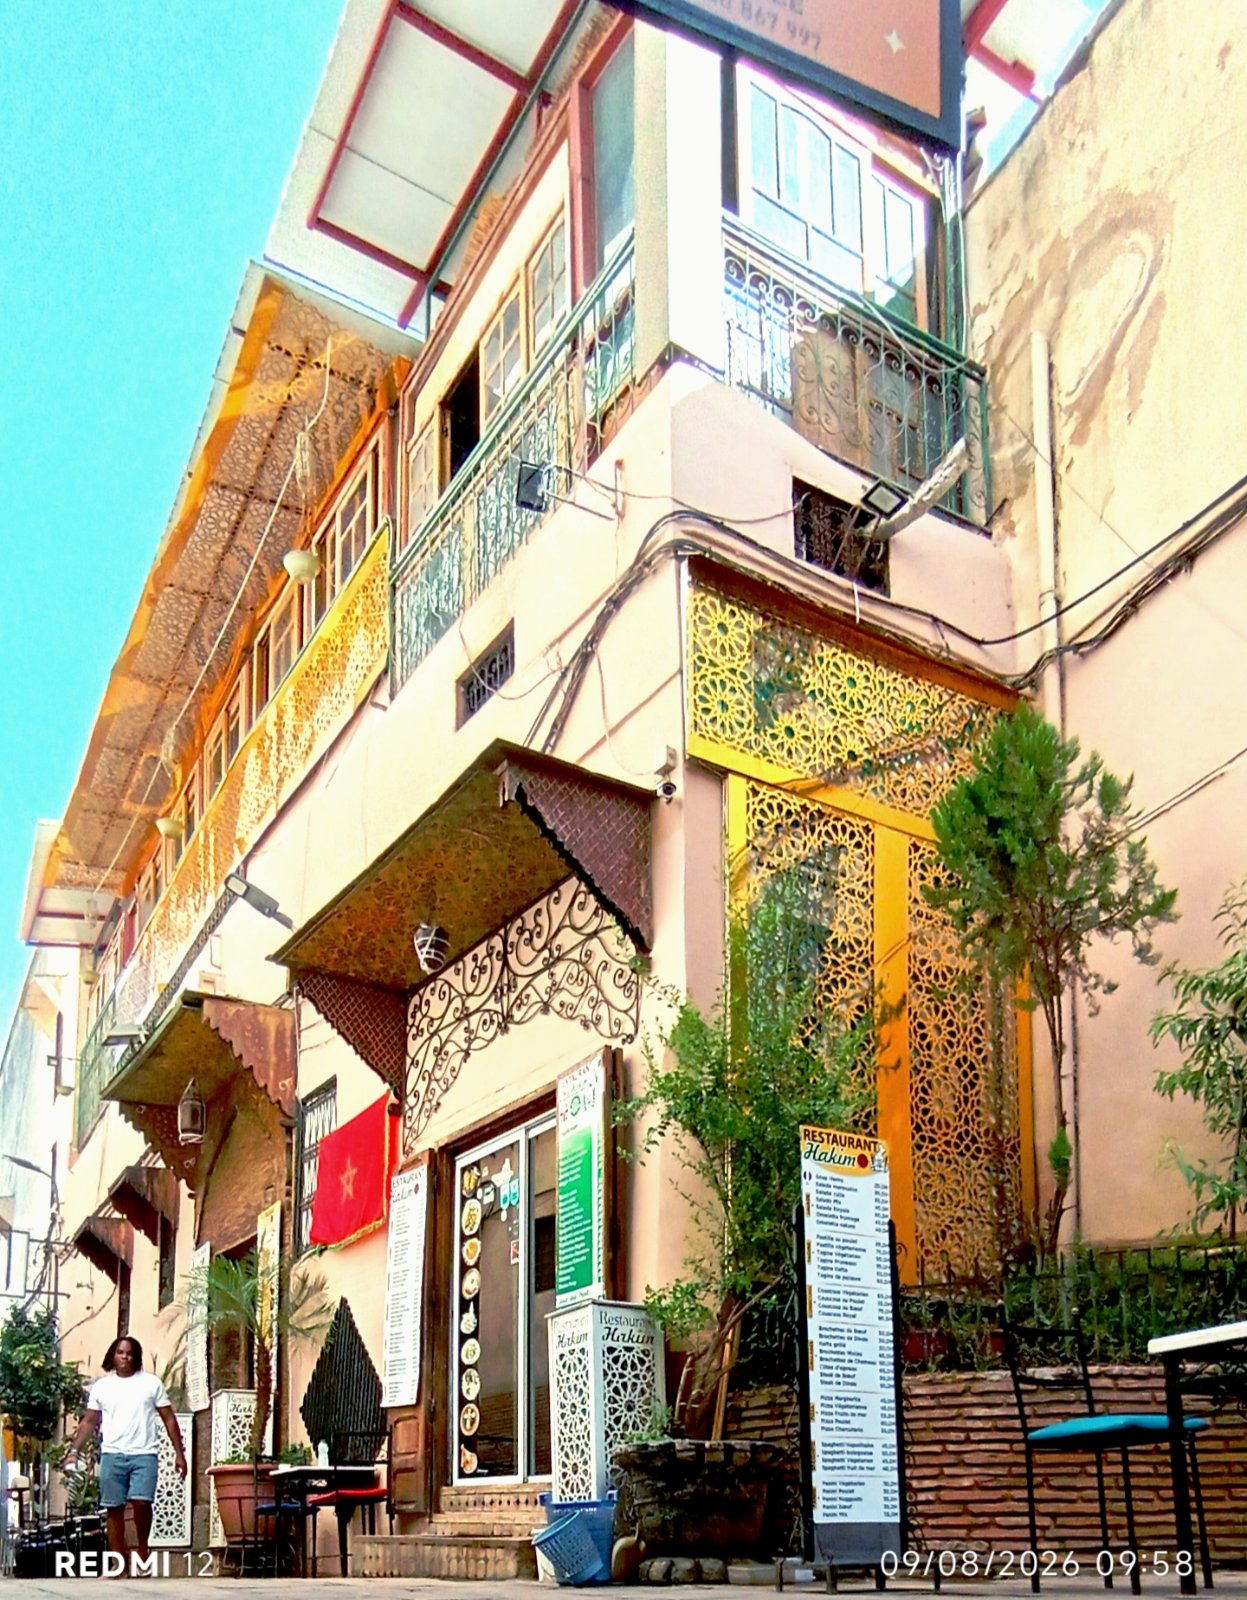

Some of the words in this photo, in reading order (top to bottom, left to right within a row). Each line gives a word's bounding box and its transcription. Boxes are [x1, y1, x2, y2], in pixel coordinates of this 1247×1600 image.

[803, 1128, 878, 1152] RESTAURANT
[803, 1142, 856, 1166] Hakim
[601, 1325, 655, 1346] Hakim
